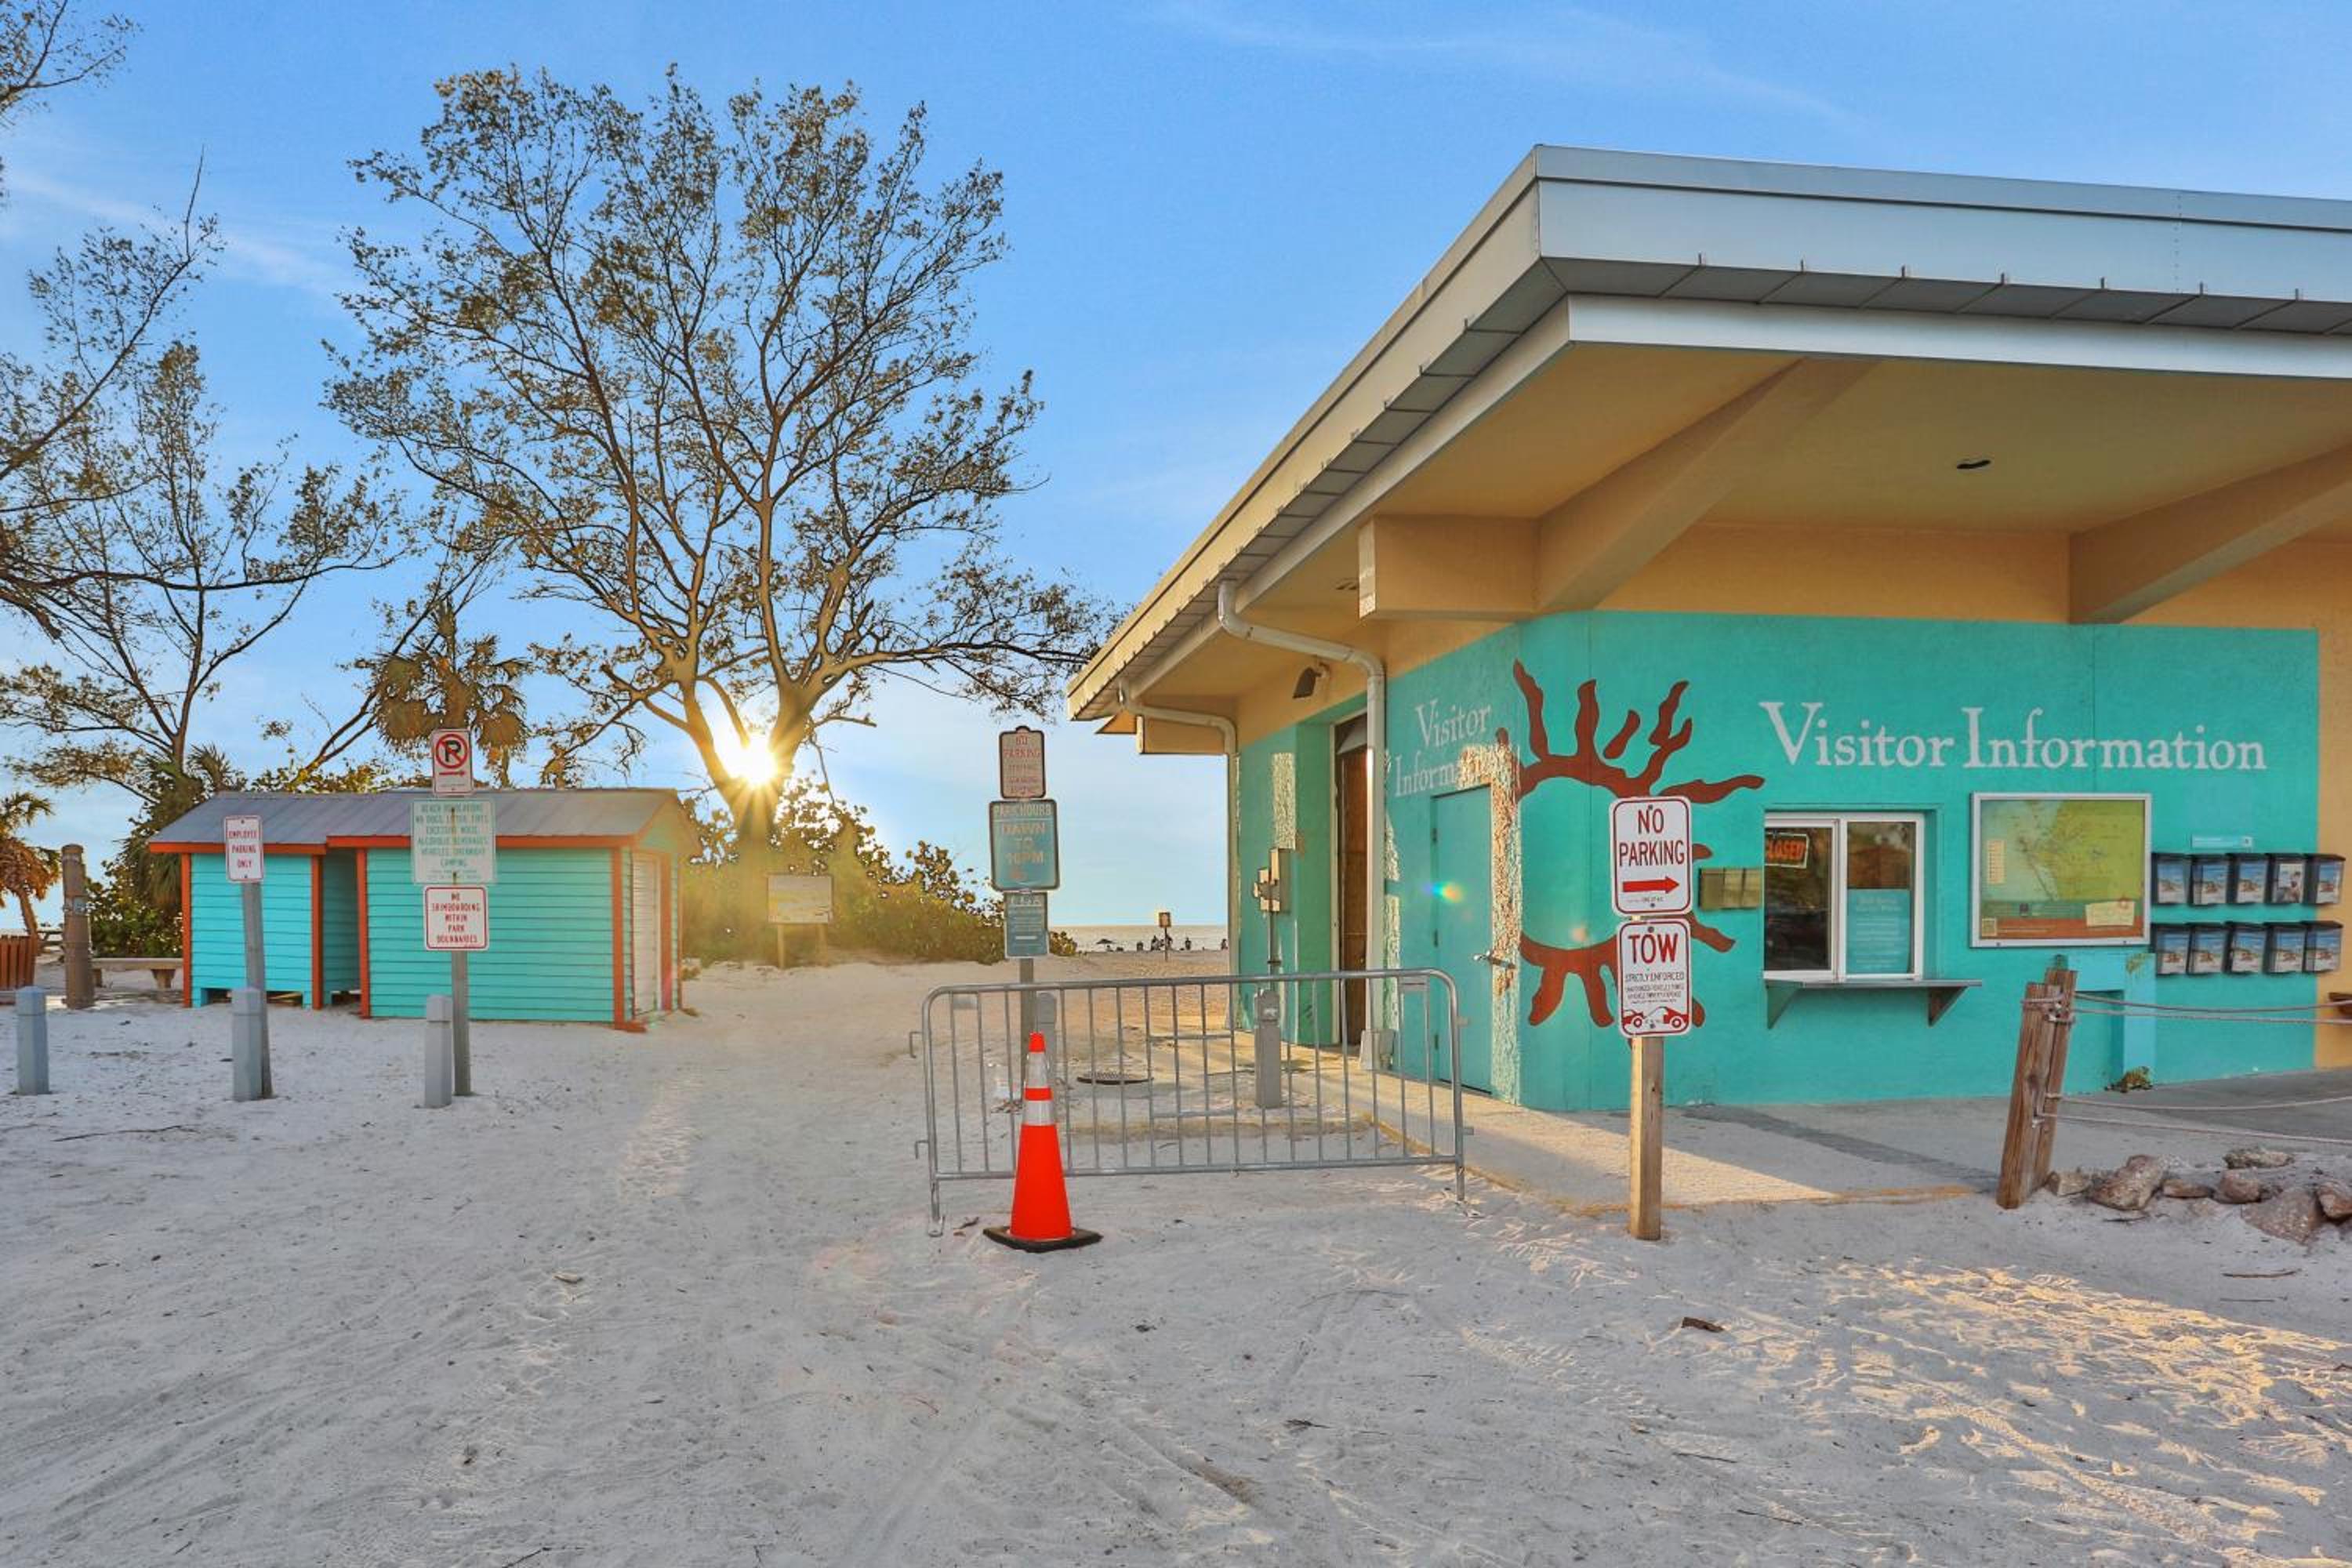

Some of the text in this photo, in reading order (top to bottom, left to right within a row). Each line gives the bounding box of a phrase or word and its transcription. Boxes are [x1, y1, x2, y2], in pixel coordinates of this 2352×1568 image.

[1414, 698, 1492, 747] Visitor
[1759, 702, 2267, 770] Visitor Information
[1004, 748, 1041, 758] PARKING
[1020, 802, 1052, 815] HOURS
[1637, 808, 1664, 833] NO
[1003, 823, 1045, 835] DAWN
[232, 844, 256, 854] PARKING
[1619, 840, 1685, 867] PARKING
[238, 858, 252, 868] ONLY
[445, 914, 467, 923] WITHIN
[448, 924, 465, 933] PARK
[1628, 932, 1679, 964] TOW
[1650, 971, 1685, 982] ENFORCED
